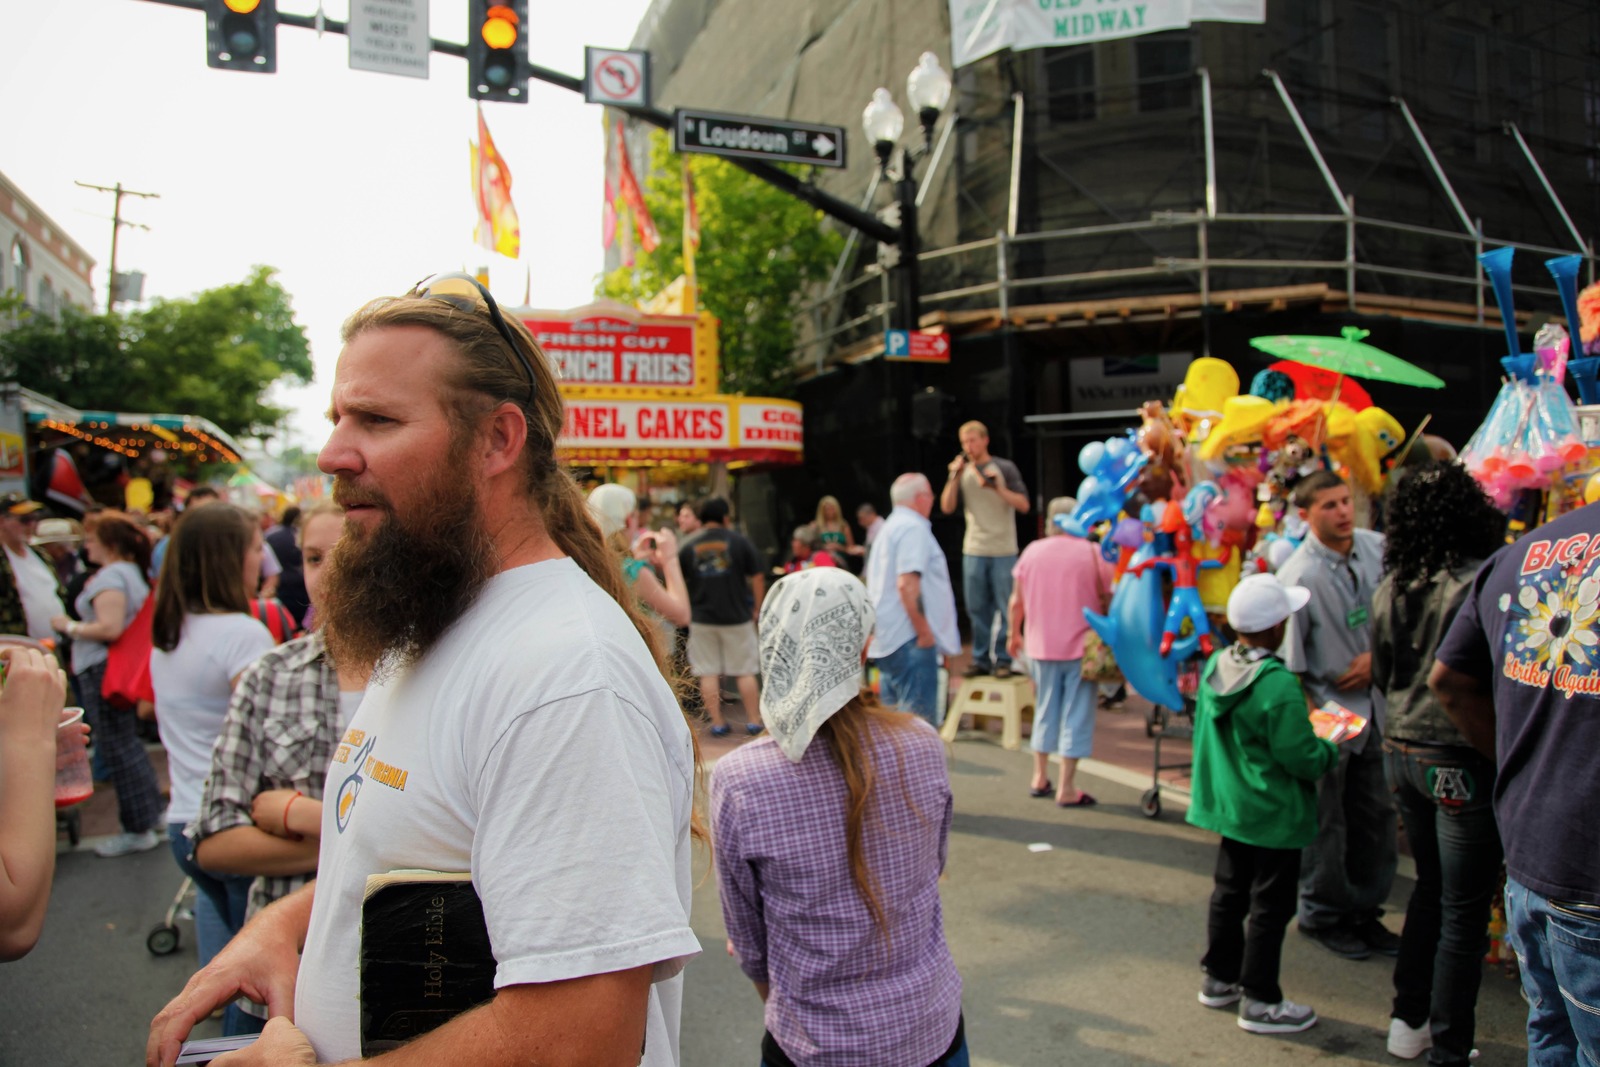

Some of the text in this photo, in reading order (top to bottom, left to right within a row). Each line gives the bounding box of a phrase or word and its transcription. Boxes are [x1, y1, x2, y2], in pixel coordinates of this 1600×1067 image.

[369, 20, 409, 38] MUST
[1053, 6, 1147, 38] MIDWAY
[698, 119, 789, 154] Loudoun
[537, 332, 671, 350] FRESH CUT
[550, 349, 694, 384] ENCH FRIES
[562, 406, 803, 441] NEL CAKES COL
[1502, 651, 1551, 689] Strike
[370, 759, 409, 792] VIRGINIA
[424, 896, 449, 998] Holy Bible
